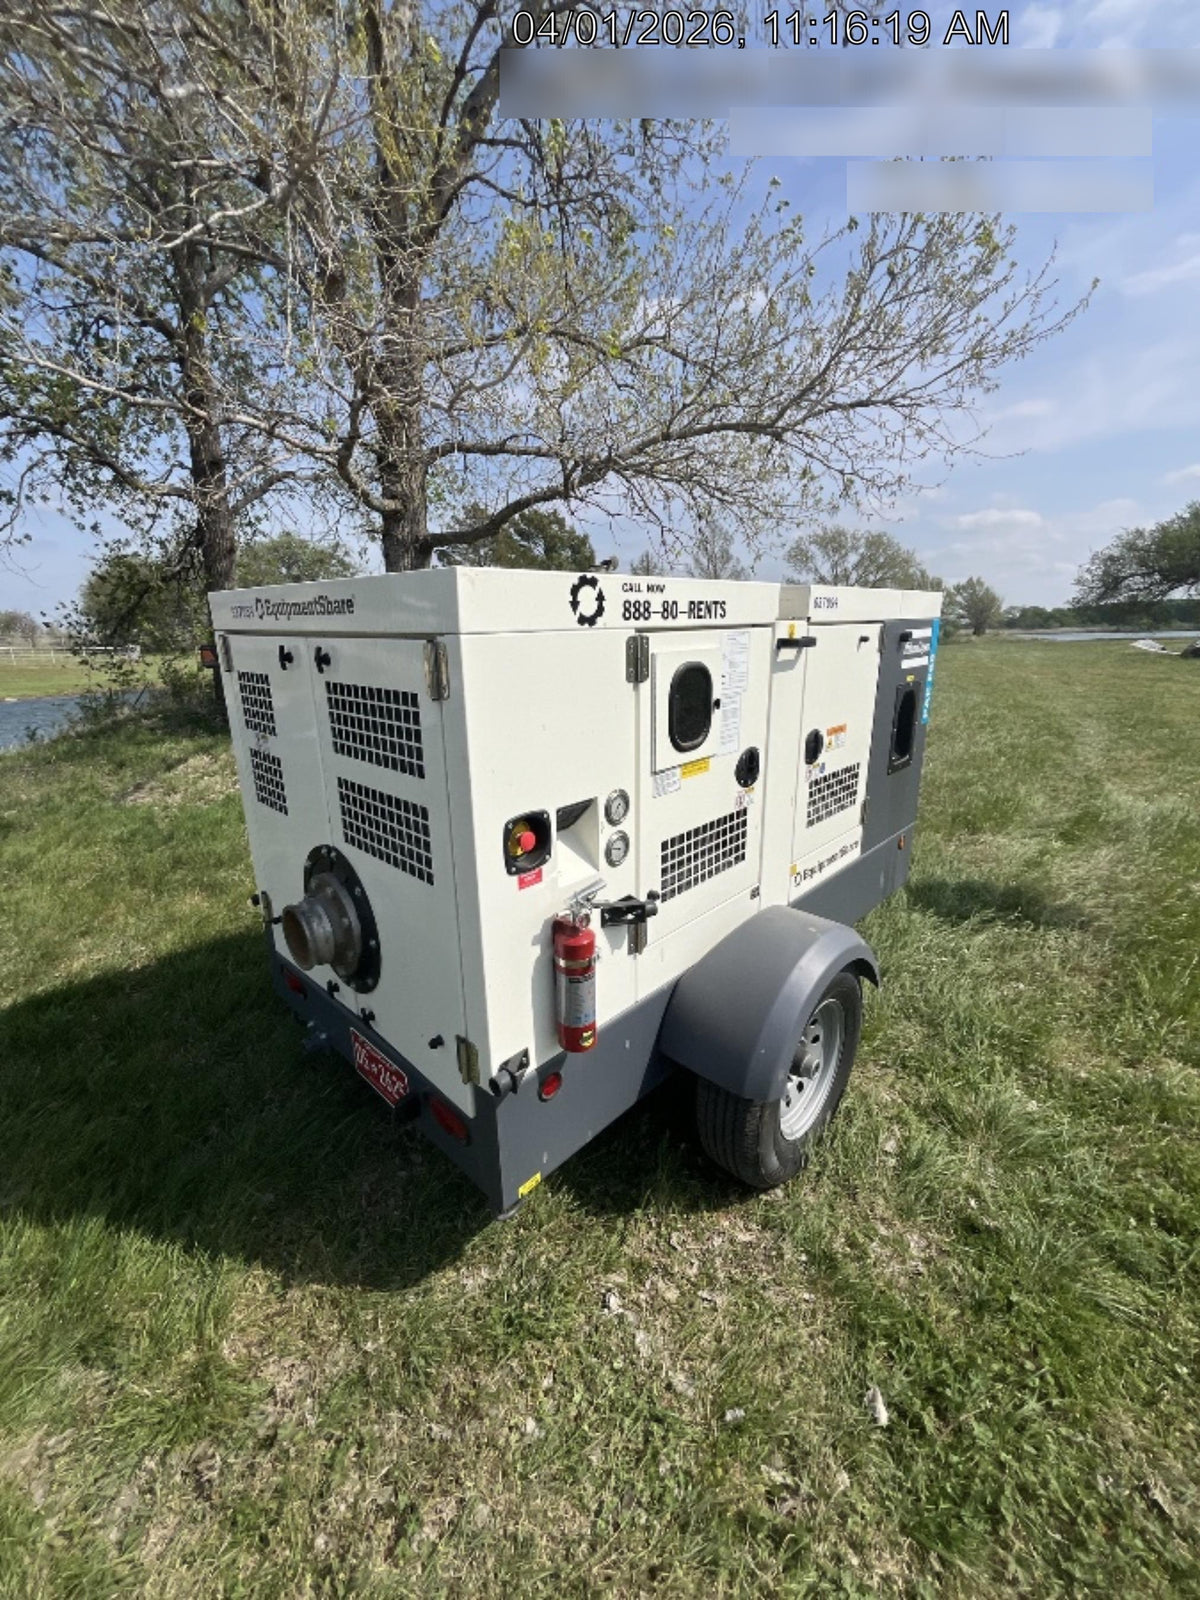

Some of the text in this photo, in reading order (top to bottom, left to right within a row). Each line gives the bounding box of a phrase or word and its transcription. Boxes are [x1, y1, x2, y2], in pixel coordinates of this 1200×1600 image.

[622, 582, 665, 593] CALL NOW
[264, 595, 354, 621] EquipmentShare
[622, 600, 726, 621] 888-80-RENTS
